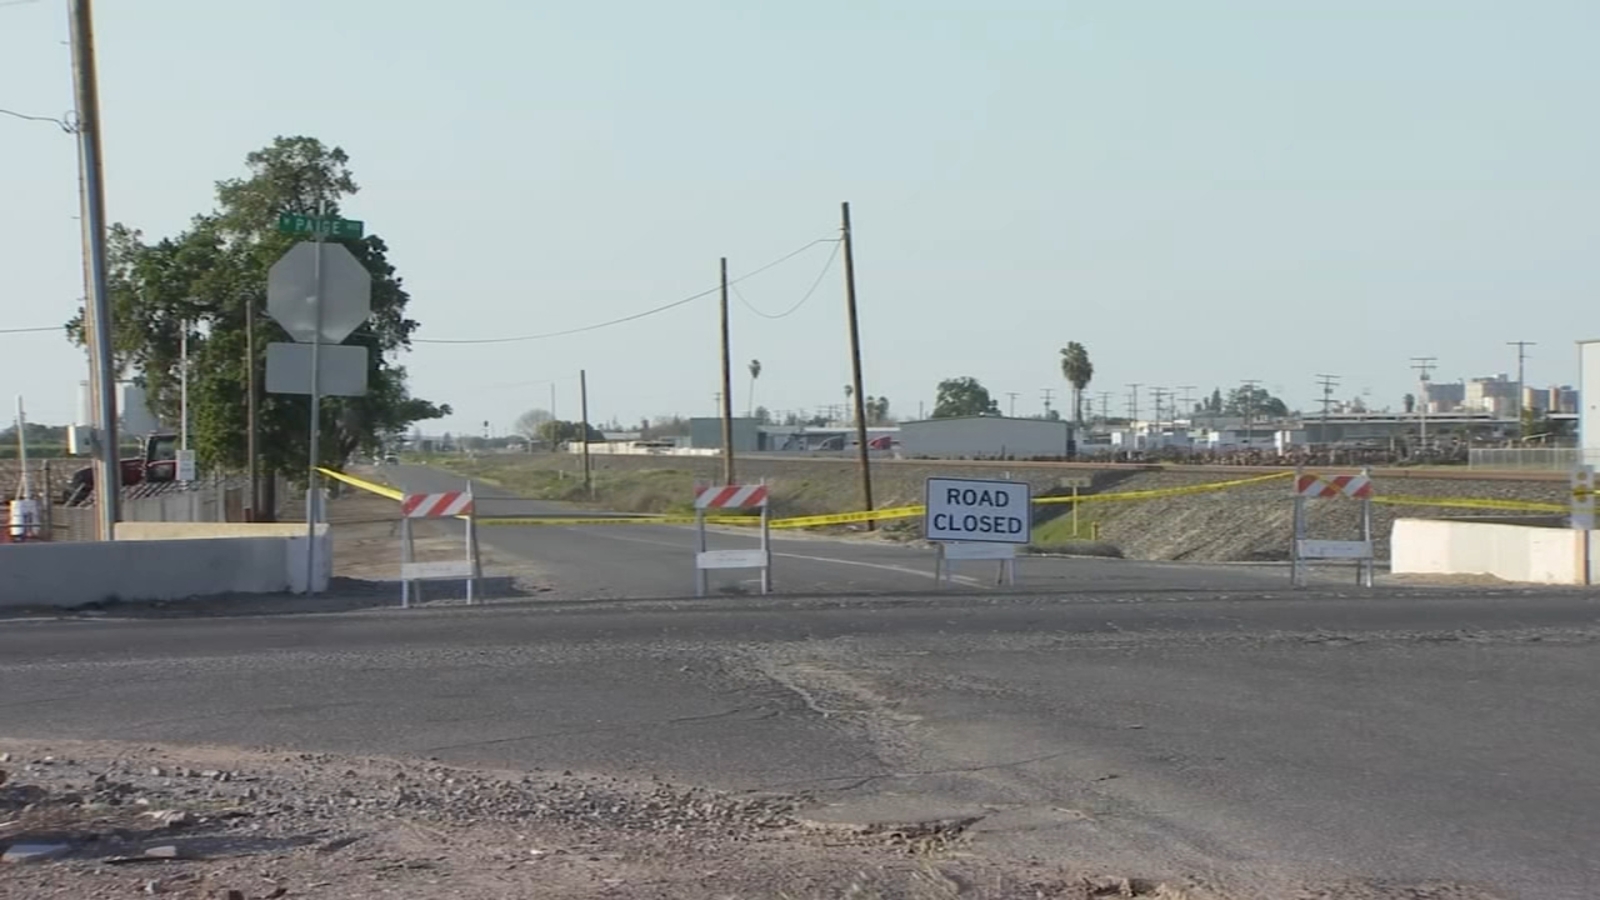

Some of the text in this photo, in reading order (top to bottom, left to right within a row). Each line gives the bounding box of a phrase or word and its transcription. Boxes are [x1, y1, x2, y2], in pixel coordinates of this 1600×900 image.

[295, 218, 341, 235] PAIGE
[946, 488, 1010, 508] ROAD
[933, 513, 1022, 534] CLOSED
